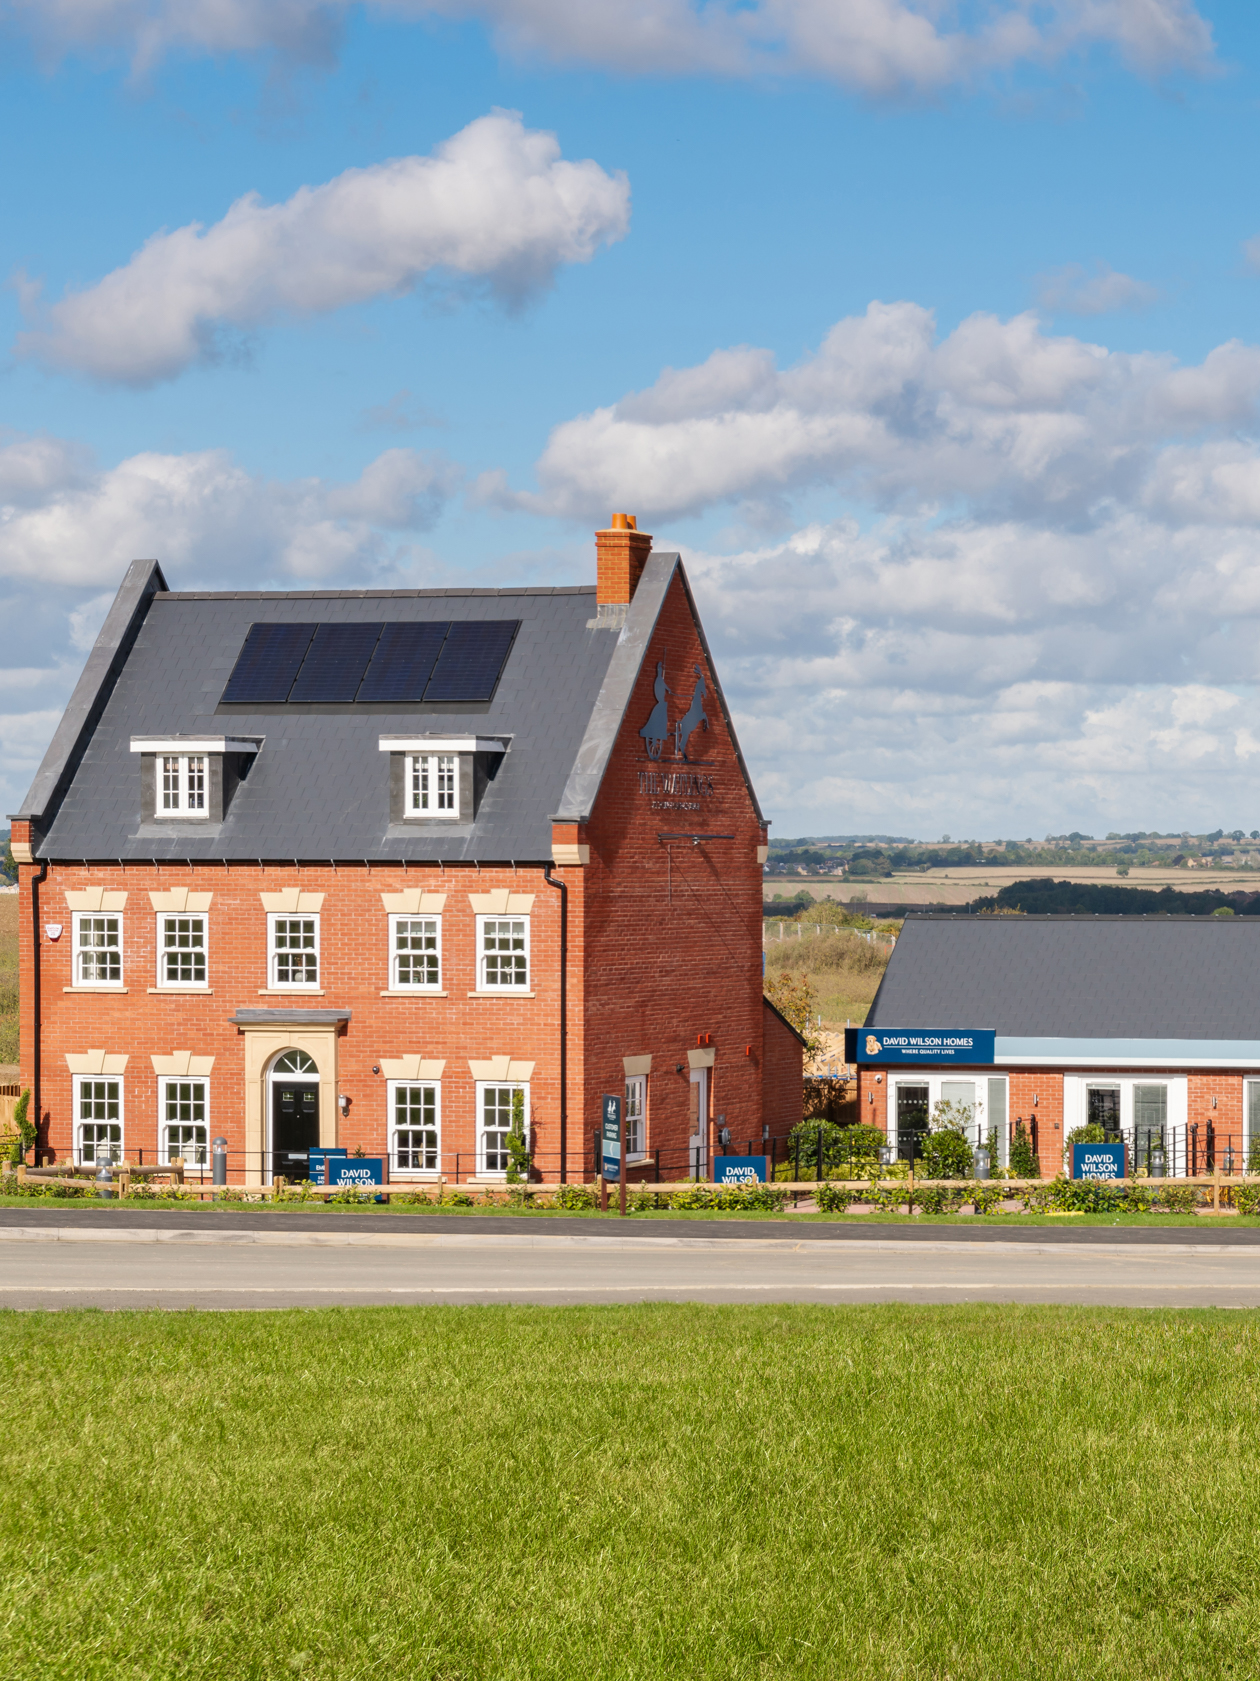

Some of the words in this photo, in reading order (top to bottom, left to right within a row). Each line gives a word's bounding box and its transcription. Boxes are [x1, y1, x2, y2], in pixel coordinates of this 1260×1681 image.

[637, 771, 660, 795] THE
[661, 773, 714, 797] WATLINGS
[883, 1037, 908, 1046] DAVID
[909, 1037, 942, 1046] WILSON
[943, 1037, 974, 1046] HOMES
[1085, 1154, 1114, 1163] DAVID
[726, 1167, 755, 1176] DAVID
[1080, 1163, 1118, 1172] WILSON
[341, 1169, 371, 1178] DAVID
[1082, 1172, 1116, 1180] HOMES
